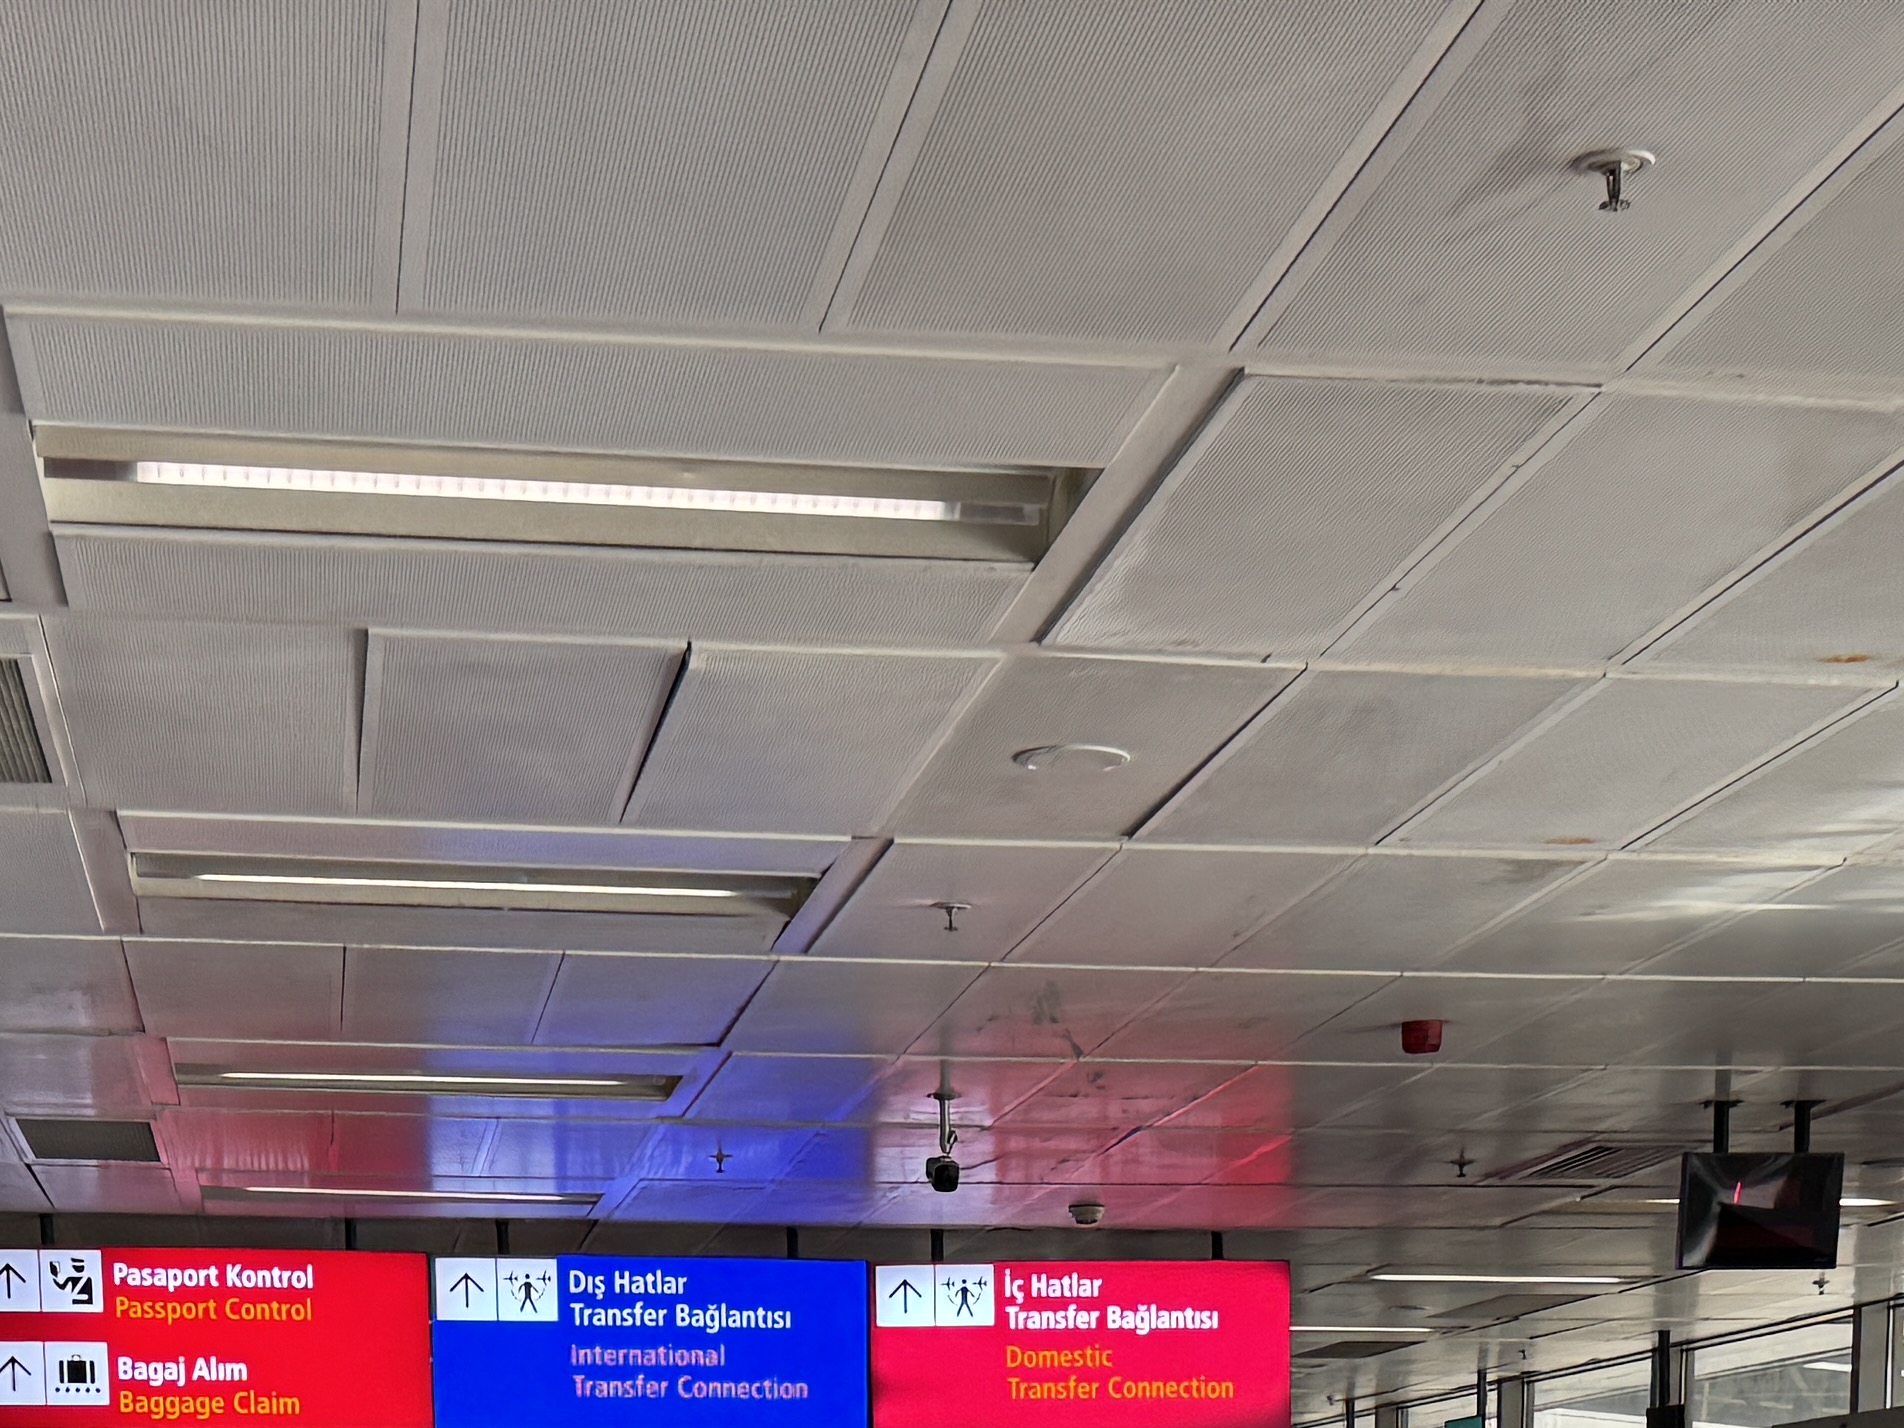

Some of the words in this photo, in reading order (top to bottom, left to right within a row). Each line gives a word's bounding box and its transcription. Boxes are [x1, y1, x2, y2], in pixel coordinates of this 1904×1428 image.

[113, 1262, 218, 1292] Pasaport
[226, 1264, 314, 1290] Kontrol
[569, 1270, 605, 1300] Dış
[614, 1270, 687, 1295] Hatlar
[1004, 1268, 1024, 1302] İç
[1031, 1270, 1103, 1298] Hatlar
[116, 1297, 217, 1324] Passport
[225, 1298, 312, 1322] Control
[570, 1303, 667, 1327] Transfer
[676, 1303, 792, 1333] Bağlantısı
[1005, 1305, 1100, 1330] Transfer
[1106, 1305, 1219, 1335] Bağlantısı
[570, 1343, 726, 1367] International
[1006, 1344, 1113, 1368] Domestic
[117, 1357, 186, 1387] Bagaj
[192, 1358, 248, 1382] Alım
[573, 1374, 668, 1398] Transfer
[677, 1375, 809, 1400] Connection
[1007, 1376, 1100, 1400] Transfer
[1108, 1376, 1234, 1399] Connection
[119, 1392, 225, 1420] Baggage
[233, 1391, 301, 1415] Claim
